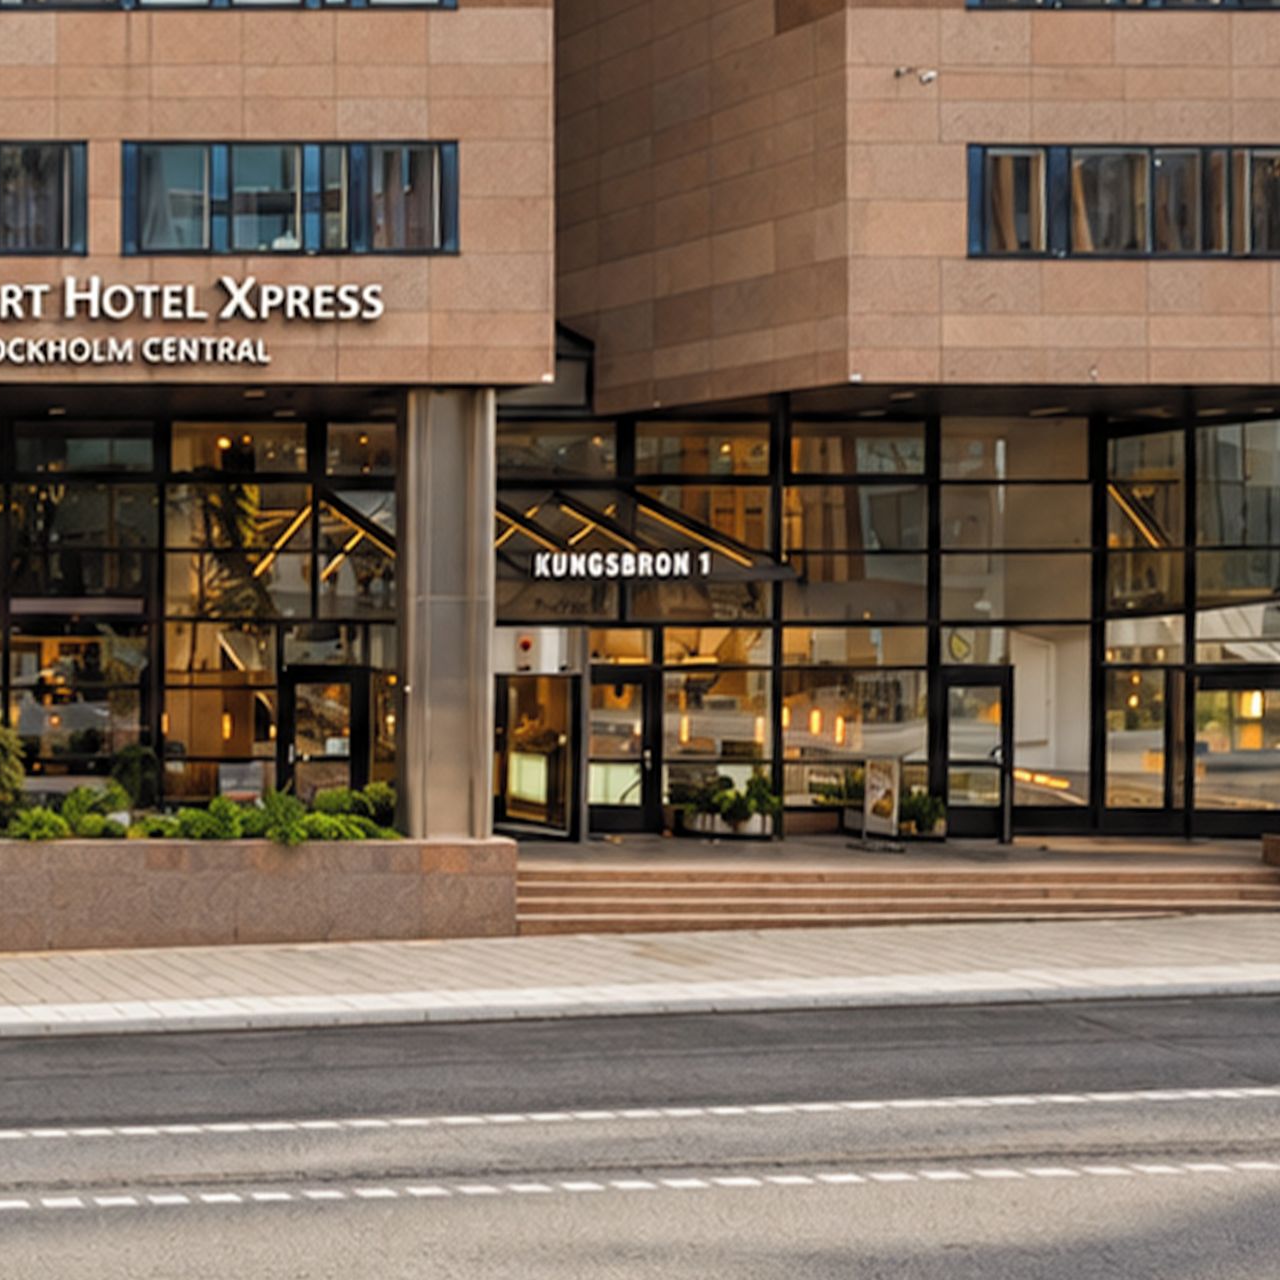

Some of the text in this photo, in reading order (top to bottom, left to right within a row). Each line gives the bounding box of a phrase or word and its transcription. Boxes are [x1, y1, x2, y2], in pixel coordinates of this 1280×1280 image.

[64, 275, 208, 320] HOTEL
[218, 275, 385, 320] XPRESS
[141, 336, 271, 363] CENTRAL
[534, 550, 712, 578] KUNGSBRON 1
